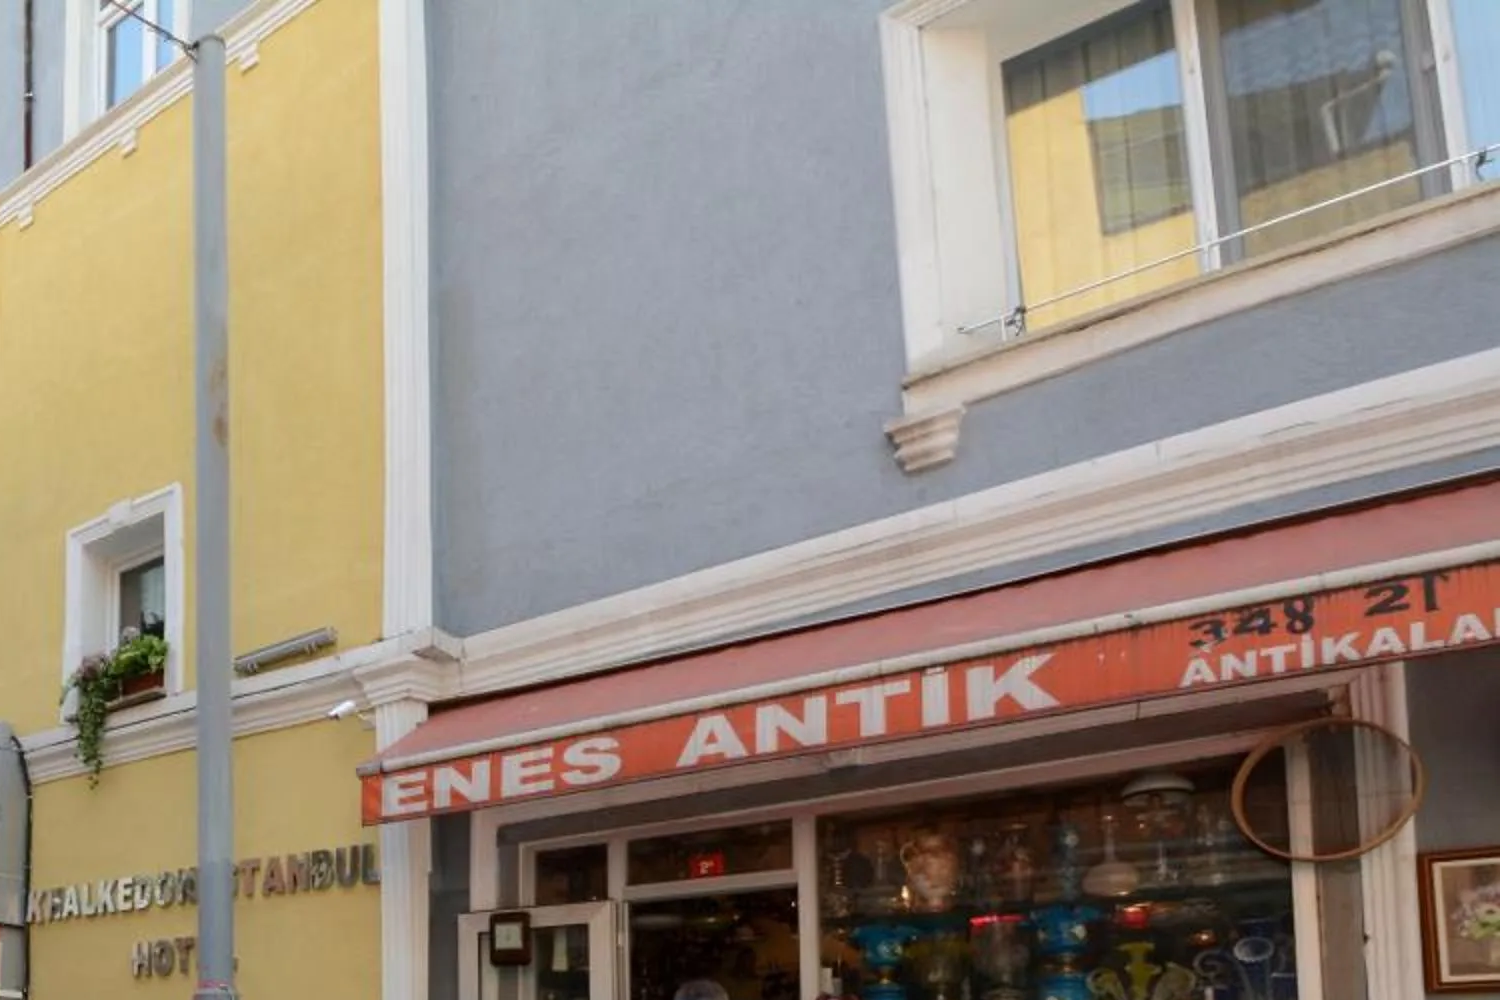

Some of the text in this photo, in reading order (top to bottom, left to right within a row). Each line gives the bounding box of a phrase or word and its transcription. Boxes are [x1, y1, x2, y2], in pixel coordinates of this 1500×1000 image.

[1179, 607, 1500, 688] ANTİKALA
[381, 653, 1060, 817] ENES ANTİK
